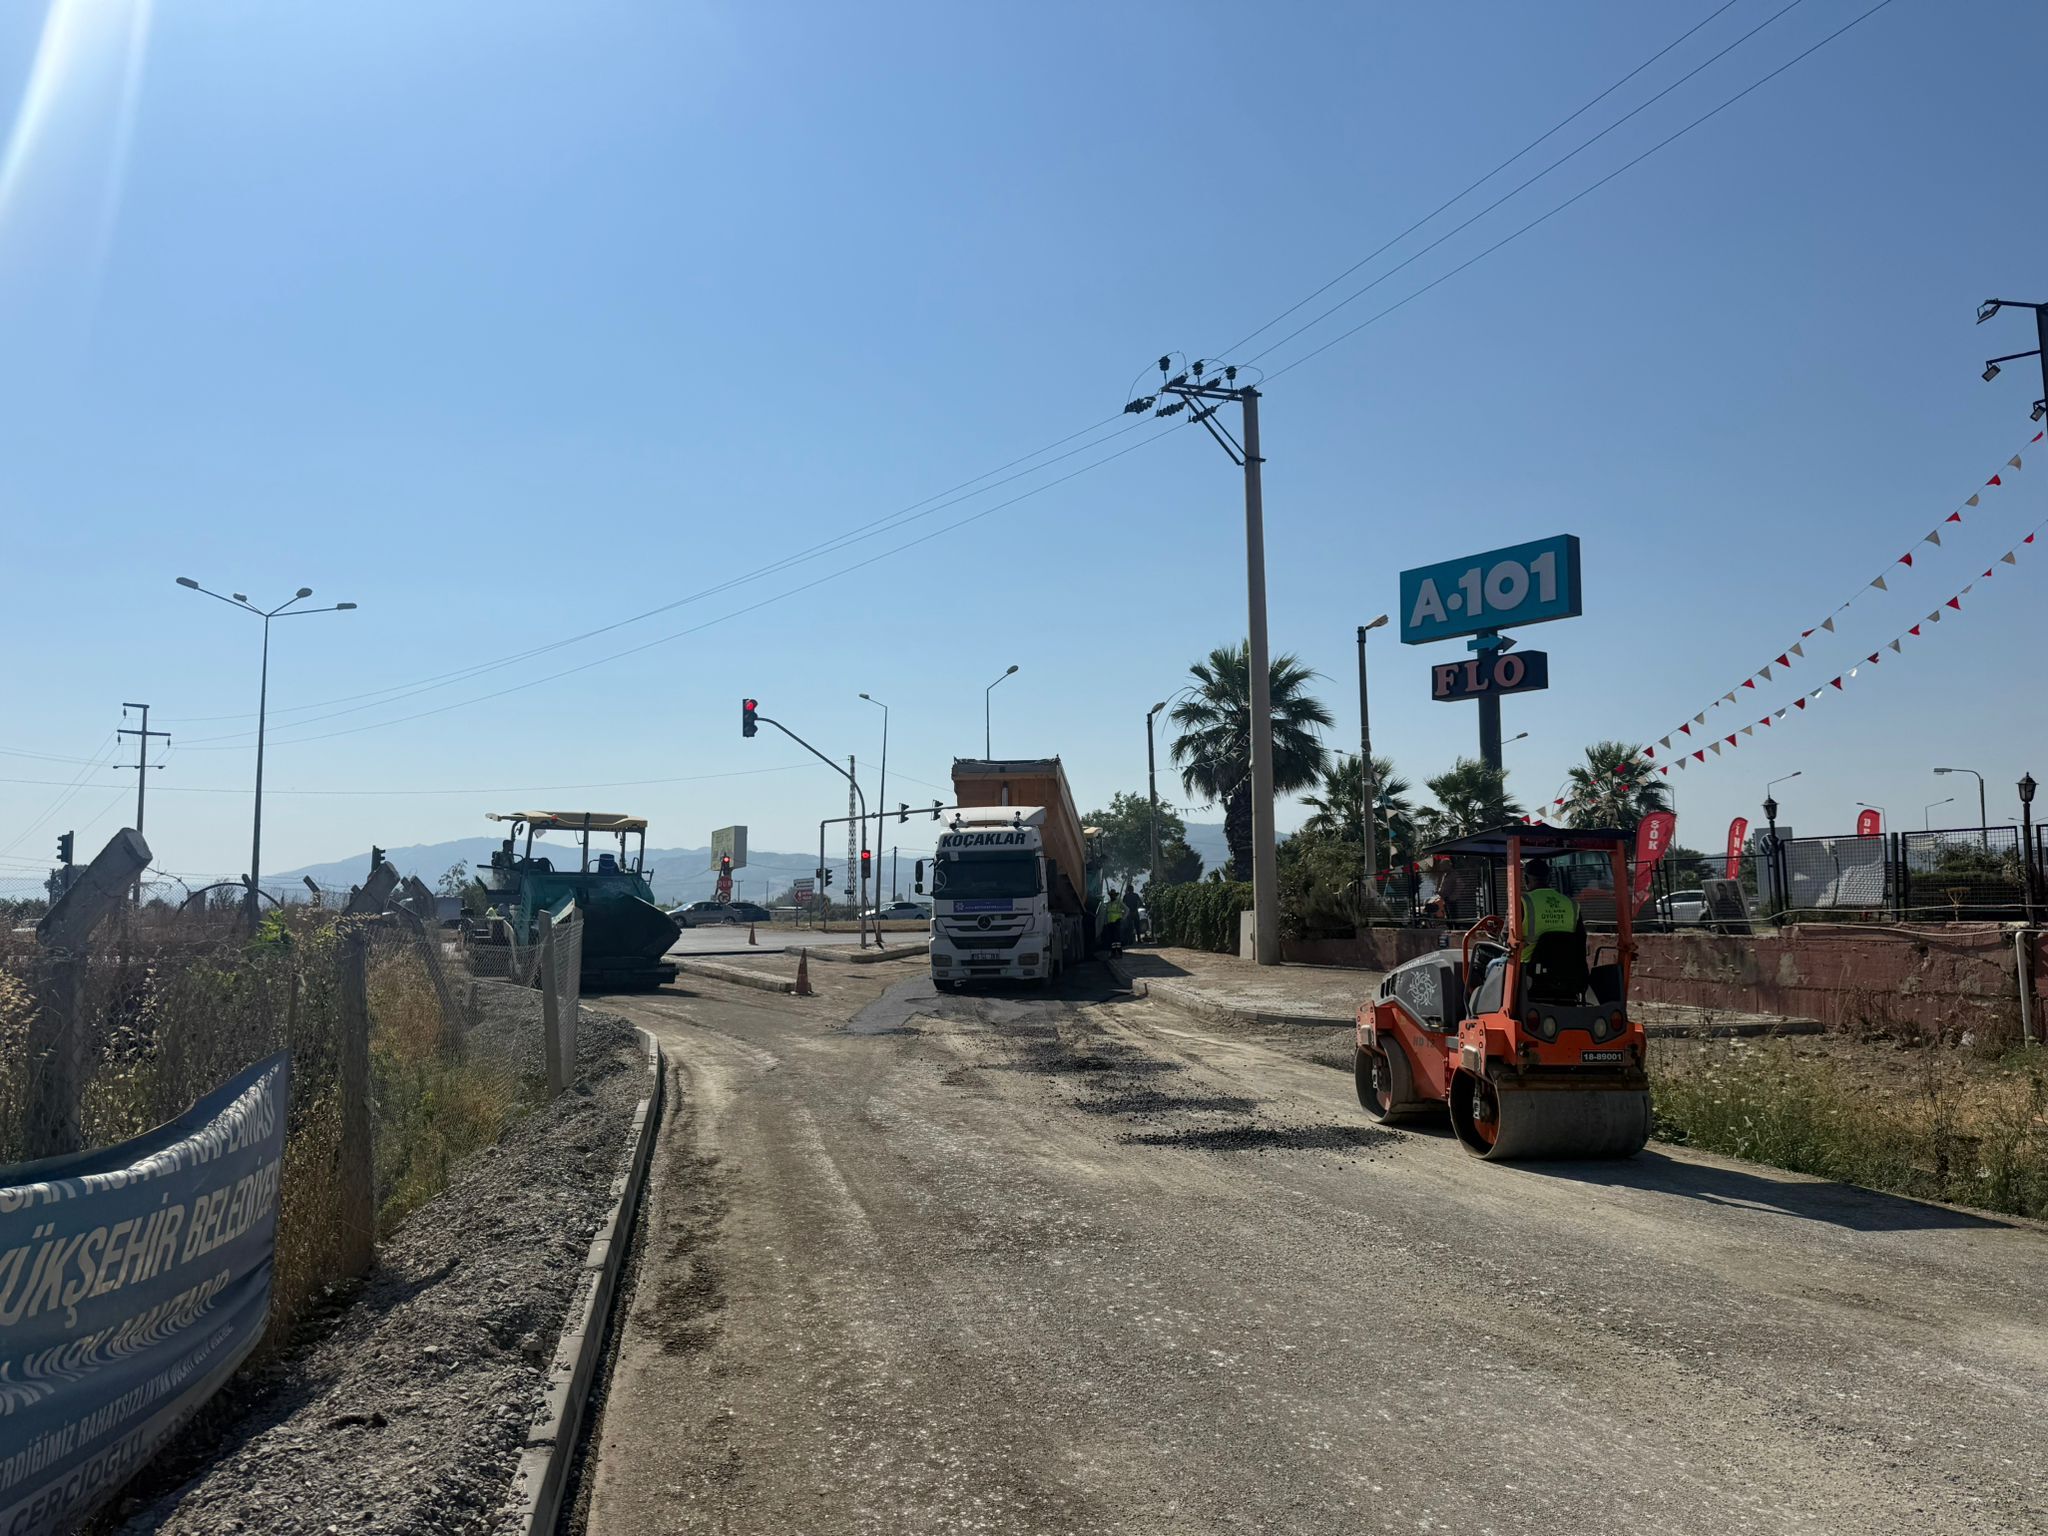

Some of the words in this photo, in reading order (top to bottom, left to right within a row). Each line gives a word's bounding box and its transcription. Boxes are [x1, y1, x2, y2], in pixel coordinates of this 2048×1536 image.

[1434, 655, 1525, 696] FLO
[942, 833, 1026, 848] KOÇAKLAR
[0, 1192, 186, 1329] ÜKŞEHİR
